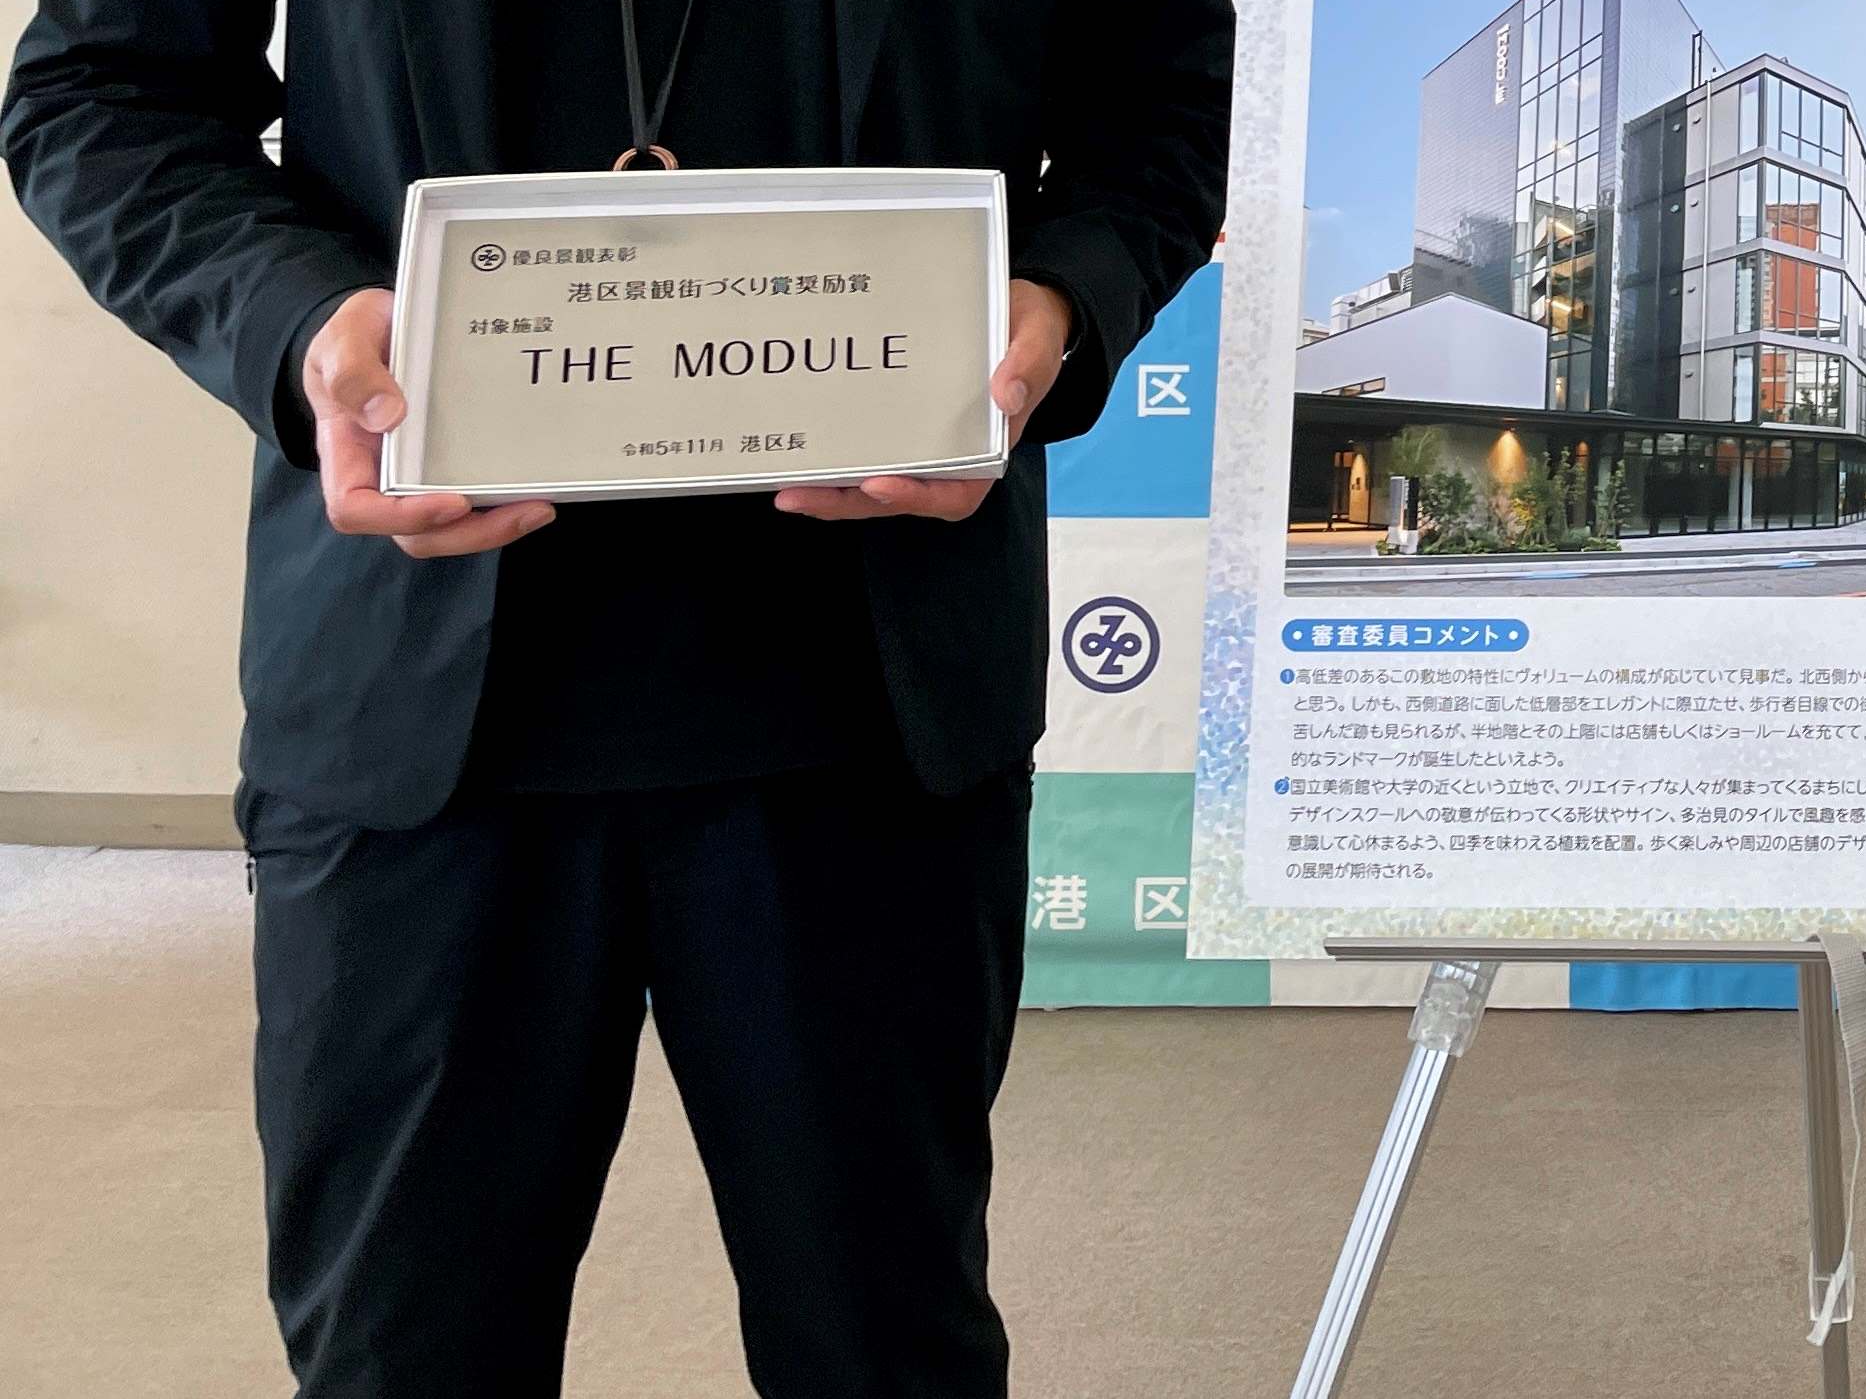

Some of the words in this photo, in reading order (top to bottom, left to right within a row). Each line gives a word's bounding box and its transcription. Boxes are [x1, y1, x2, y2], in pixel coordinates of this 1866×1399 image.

[512, 245, 638, 267] 優良景観表彰
[567, 272, 872, 303] 港区景観街づくり賞奨励賞
[469, 316, 555, 335] 対象施設
[521, 345, 634, 385] THE
[674, 334, 910, 379] MODULE
[1138, 363, 1191, 418] 区
[622, 437, 725, 458] 令和5年11月
[739, 432, 808, 454] 港区長
[1311, 624, 1500, 647] 審査委員コメント
